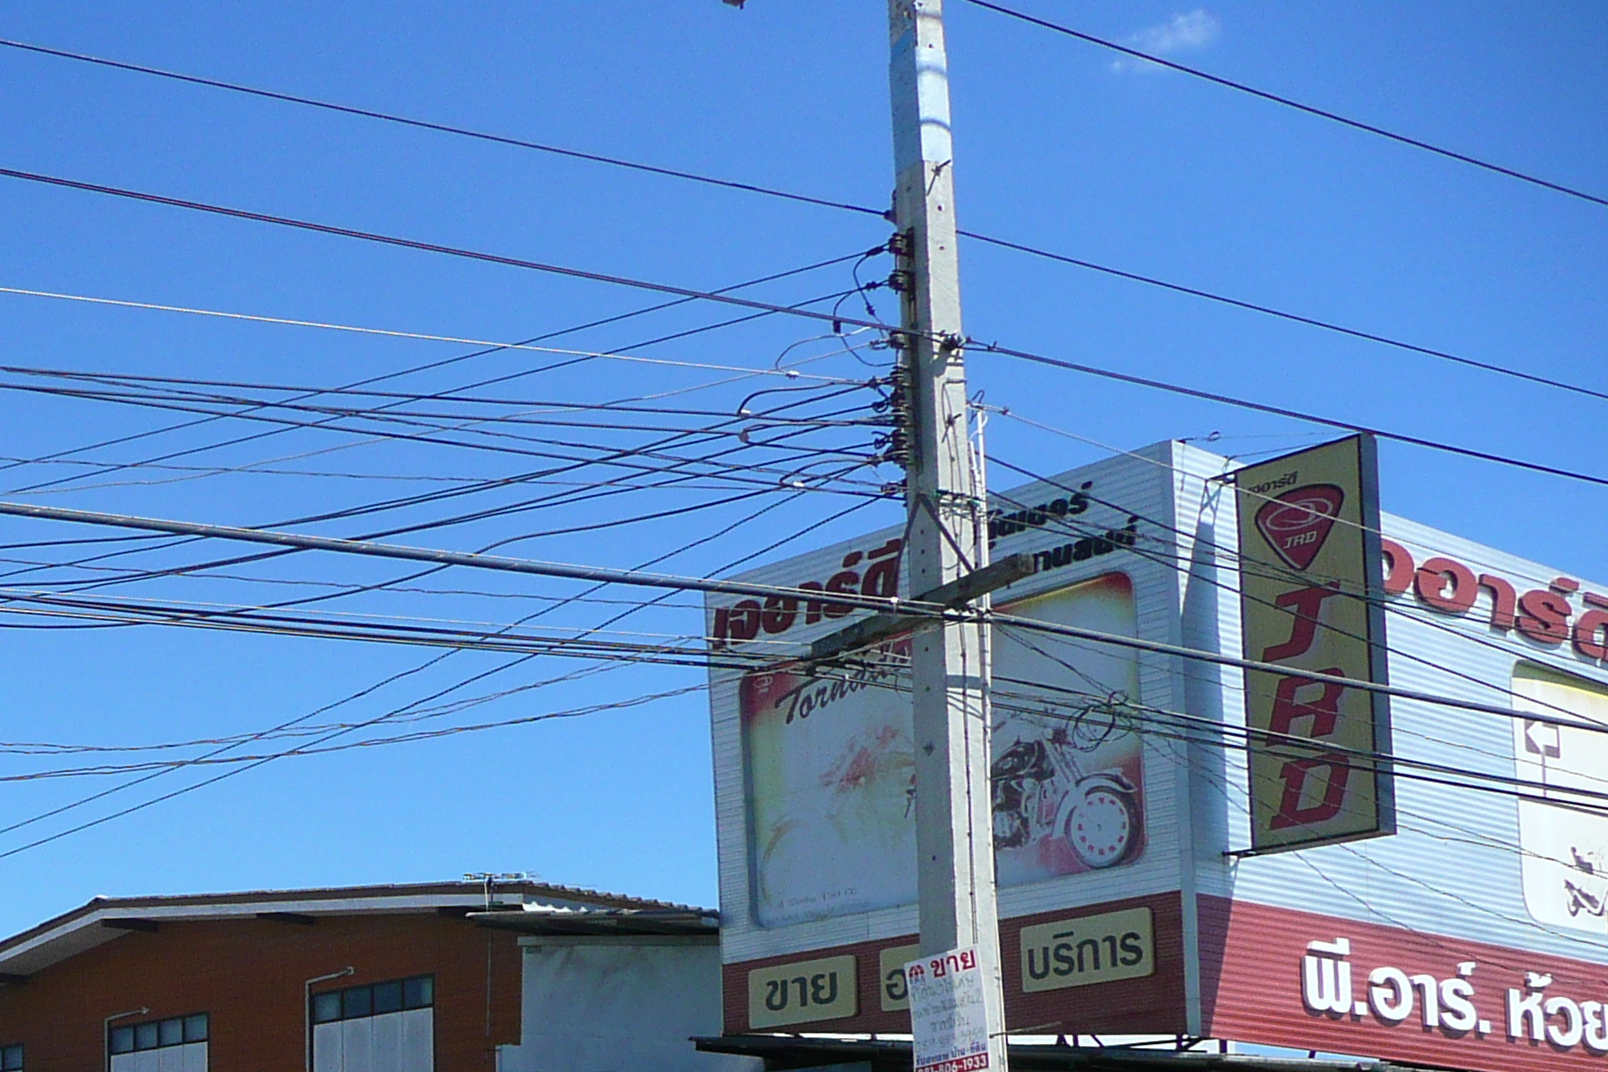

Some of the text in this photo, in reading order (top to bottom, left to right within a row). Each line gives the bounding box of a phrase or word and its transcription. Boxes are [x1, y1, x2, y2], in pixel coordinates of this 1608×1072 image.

[1283, 529, 1318, 549] JRD
[1261, 580, 1351, 832] JRD
[930, 949, 976, 978] ขาย
[1028, 931, 1143, 981] บริการ
[765, 971, 839, 1012] ขาย
[1300, 937, 1492, 1036] พี.อาร์.
